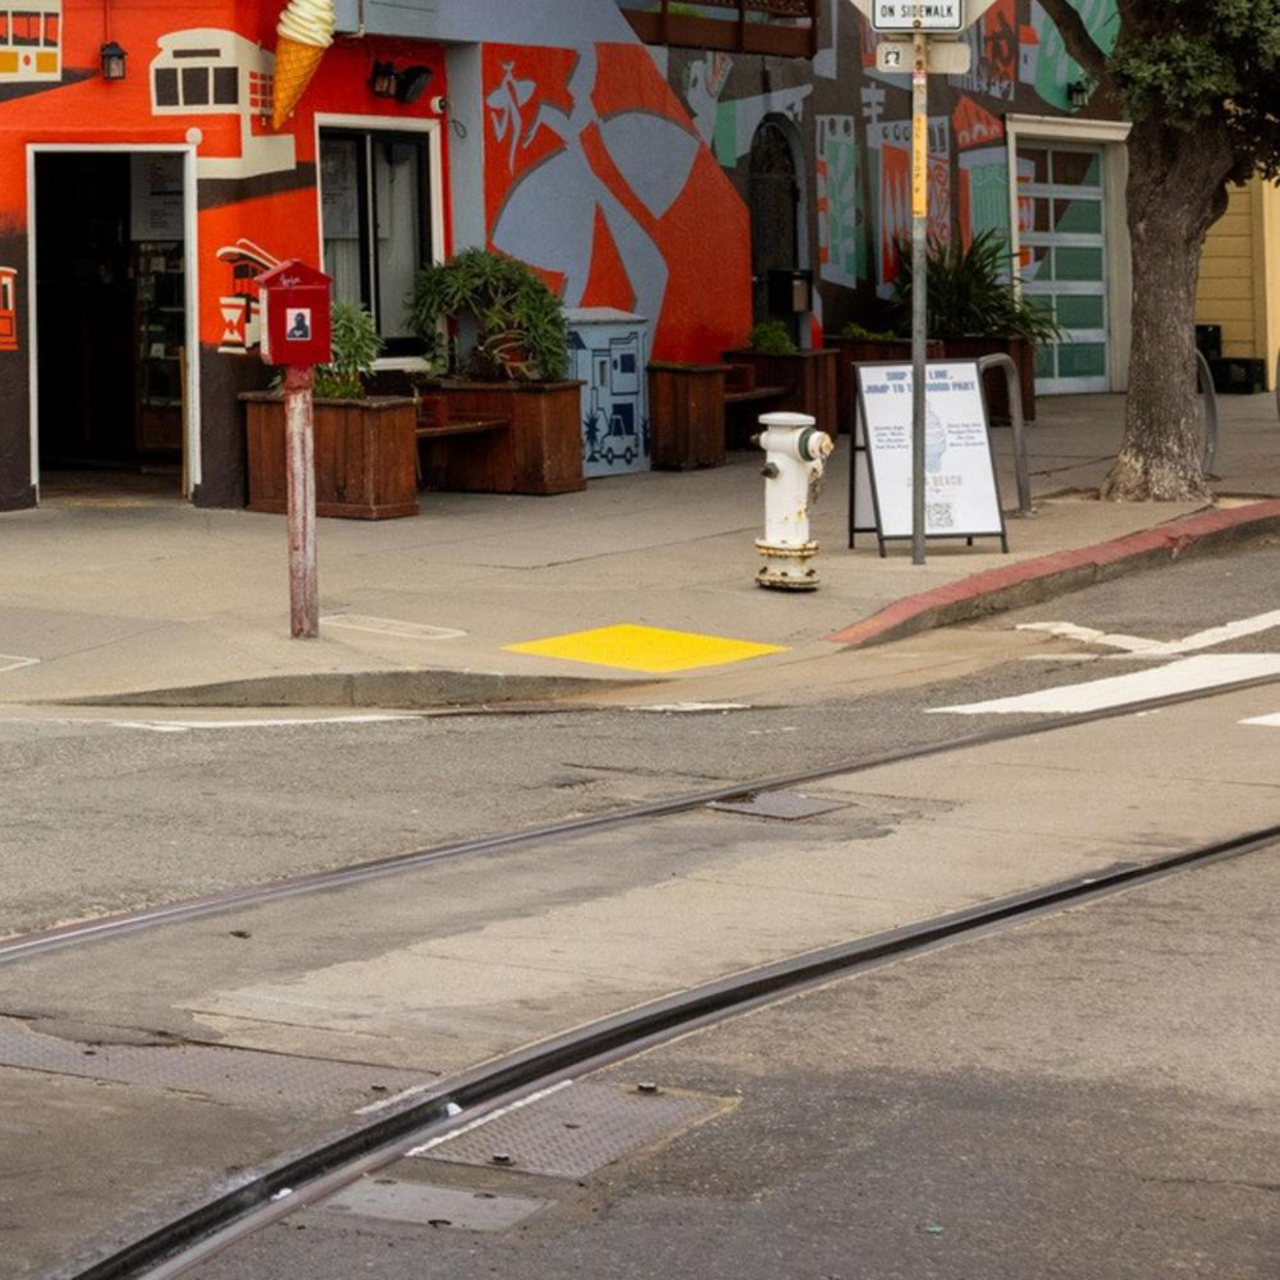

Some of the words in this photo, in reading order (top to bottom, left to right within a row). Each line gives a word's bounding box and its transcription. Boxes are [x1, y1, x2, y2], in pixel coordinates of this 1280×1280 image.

[880, 4, 895, 18] ON
[901, 4, 953, 18] SIDEWALK
[892, 383, 905, 393] TO
